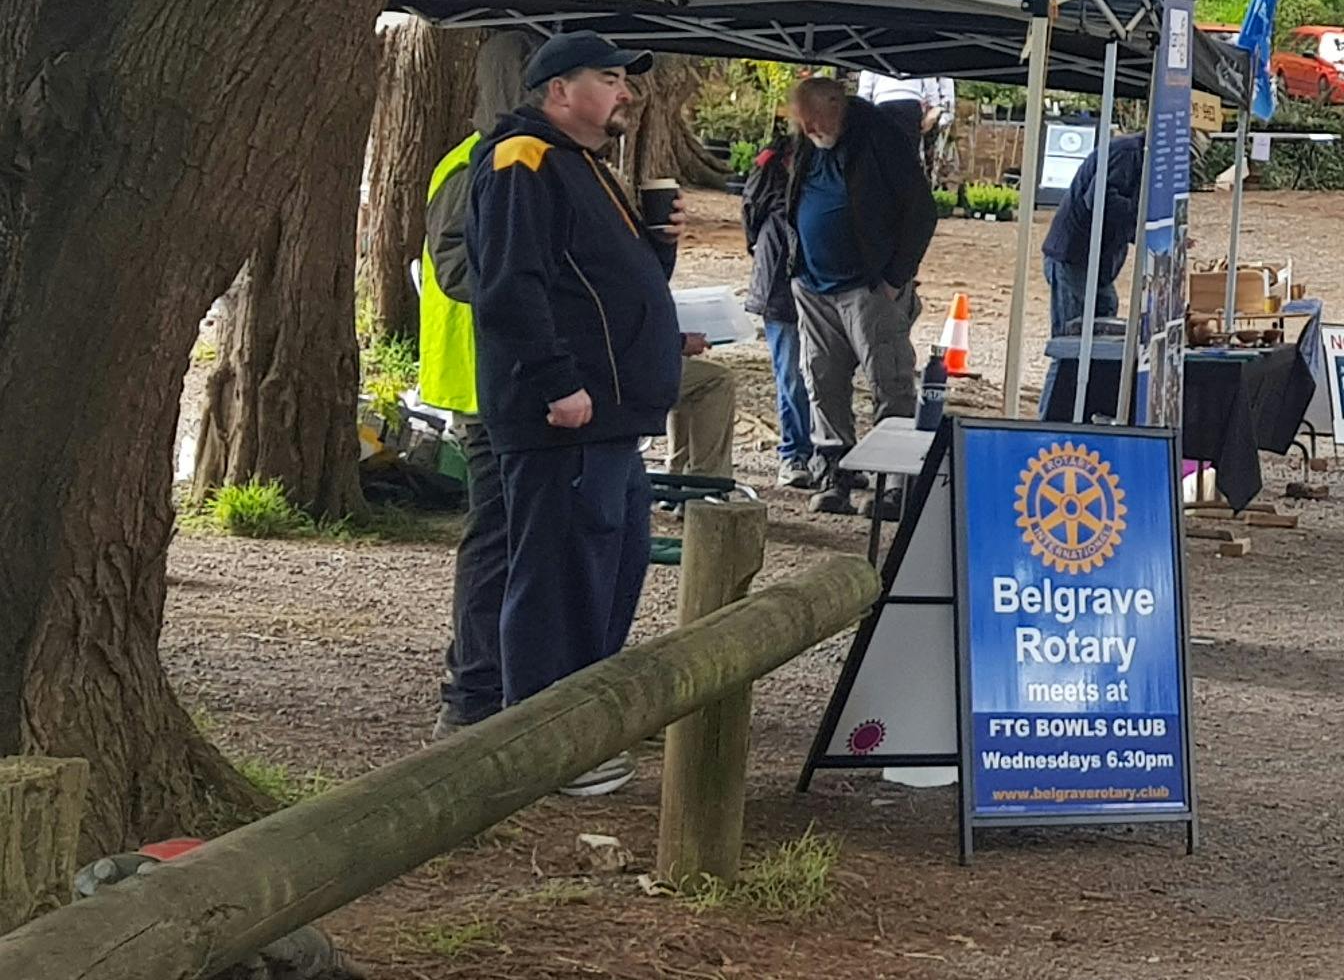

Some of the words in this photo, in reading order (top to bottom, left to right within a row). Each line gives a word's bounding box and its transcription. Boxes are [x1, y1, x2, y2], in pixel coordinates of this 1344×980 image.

[1046, 456, 1092, 471] ROTARY
[1033, 524, 1113, 560] INTERNATIONAL
[992, 576, 1155, 623] Belgrave
[1015, 626, 1137, 673] Rotary
[1028, 680, 1100, 702] meets
[1106, 679, 1129, 702] at
[989, 718, 1030, 737] FTG
[1035, 718, 1108, 737] BOWLS
[1113, 718, 1167, 737] CLUB
[982, 751, 1101, 772] Wednesdays
[1106, 750, 1174, 771] 6.30pm
[992, 784, 1170, 803] www.belgraverotary.club
